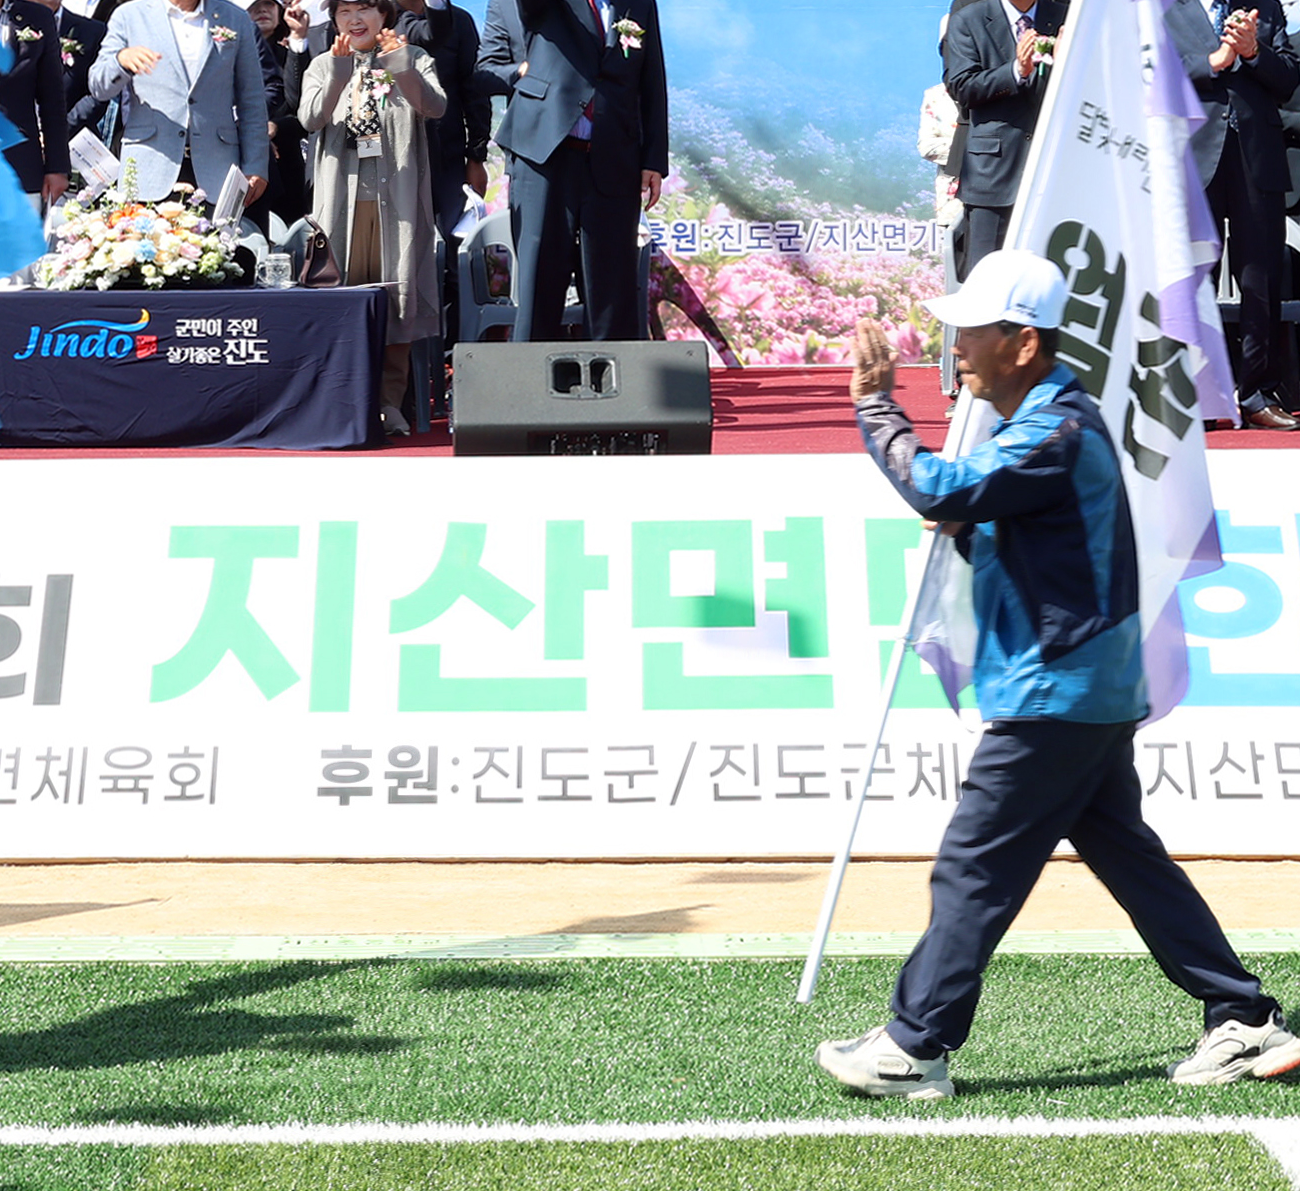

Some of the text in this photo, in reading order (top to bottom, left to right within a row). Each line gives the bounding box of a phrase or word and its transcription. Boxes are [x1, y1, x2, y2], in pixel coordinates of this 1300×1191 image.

[175, 318, 258, 338] 군민이 주인
[13, 325, 134, 361] Jindo
[222, 338, 270, 366] 진도
